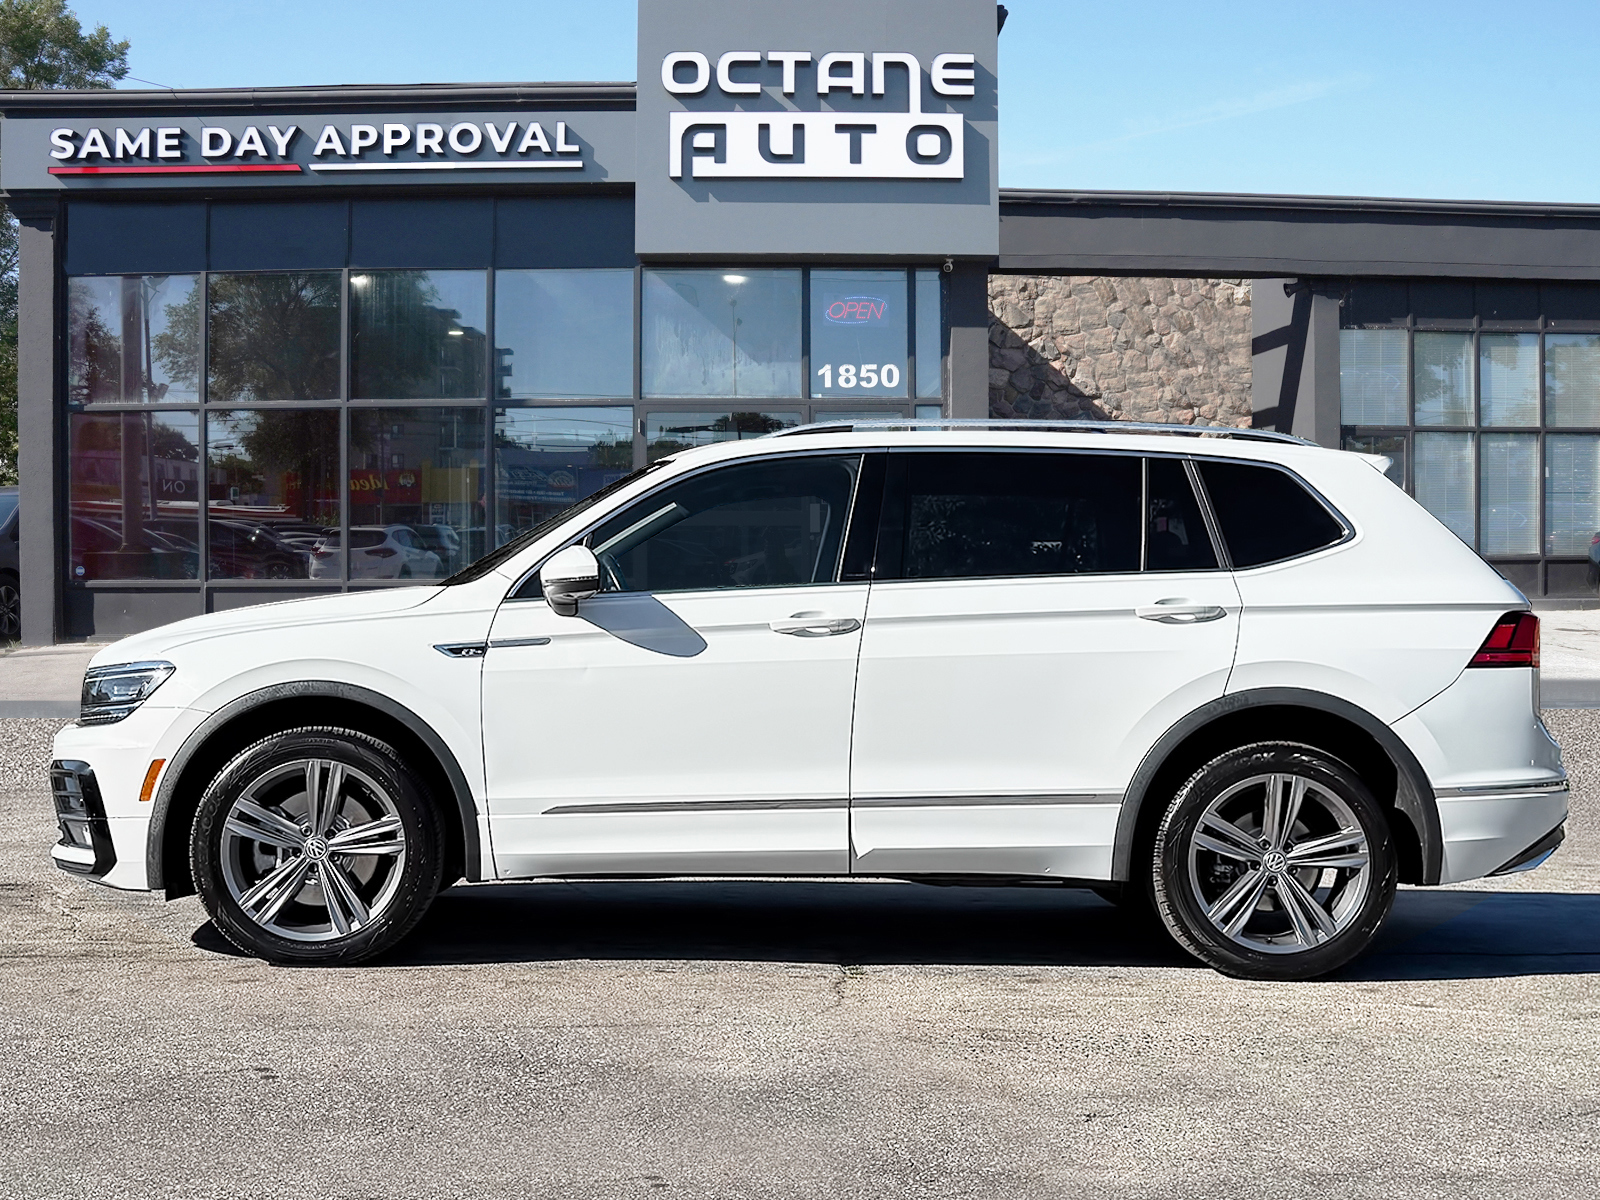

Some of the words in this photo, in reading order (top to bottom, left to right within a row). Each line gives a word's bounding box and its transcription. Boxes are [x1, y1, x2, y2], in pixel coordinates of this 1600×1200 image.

[660, 50, 976, 98] OCTANE
[48, 126, 182, 160] SAME
[200, 124, 299, 159] DAY
[312, 121, 580, 157] APPROVAL
[680, 122, 953, 173] AUTO
[828, 301, 885, 320] OPEN
[817, 363, 900, 389] 1850
